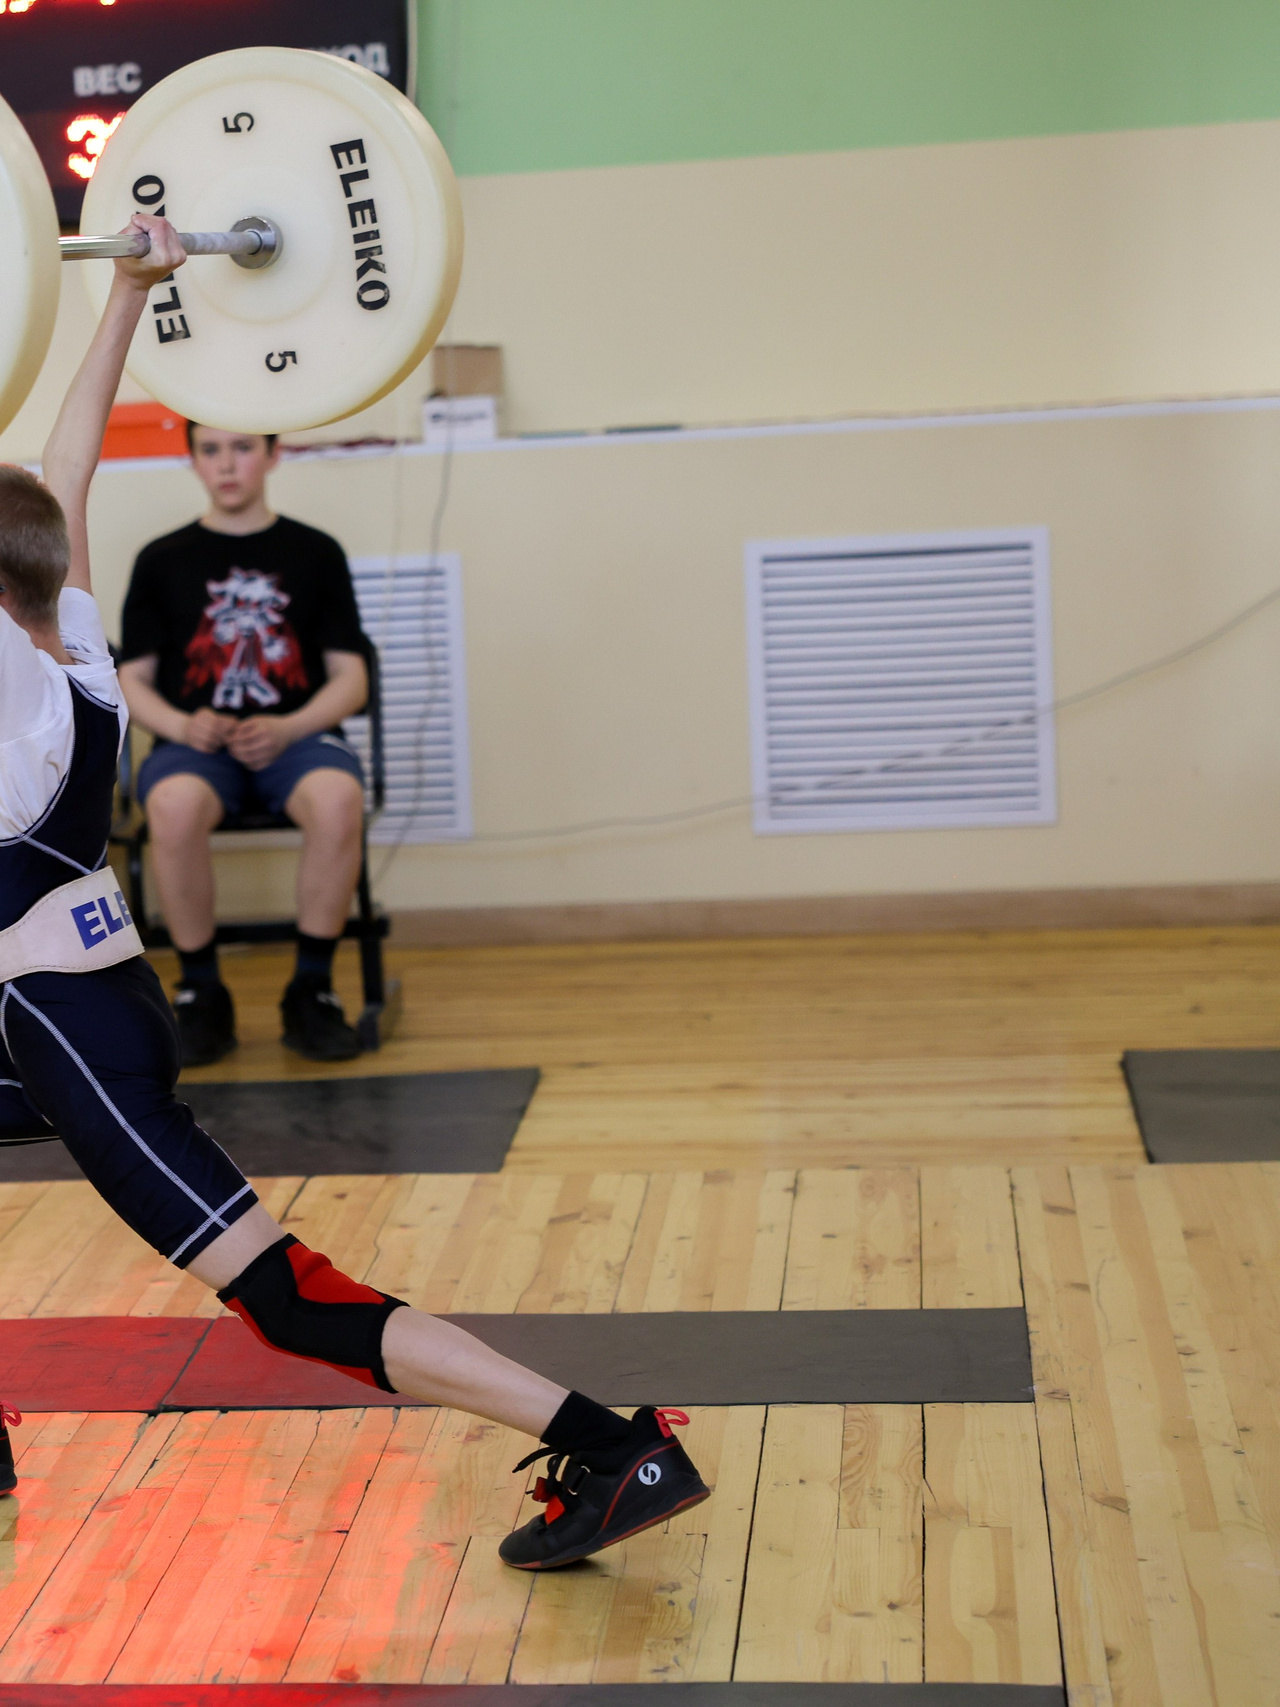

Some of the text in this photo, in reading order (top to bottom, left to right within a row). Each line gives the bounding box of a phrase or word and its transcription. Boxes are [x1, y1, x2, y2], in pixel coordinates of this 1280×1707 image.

[73, 62, 142, 97] ВЕС
[222, 112, 255, 134] 5
[330, 138, 390, 311] ELEIKO
[265, 350, 298, 373] 5
